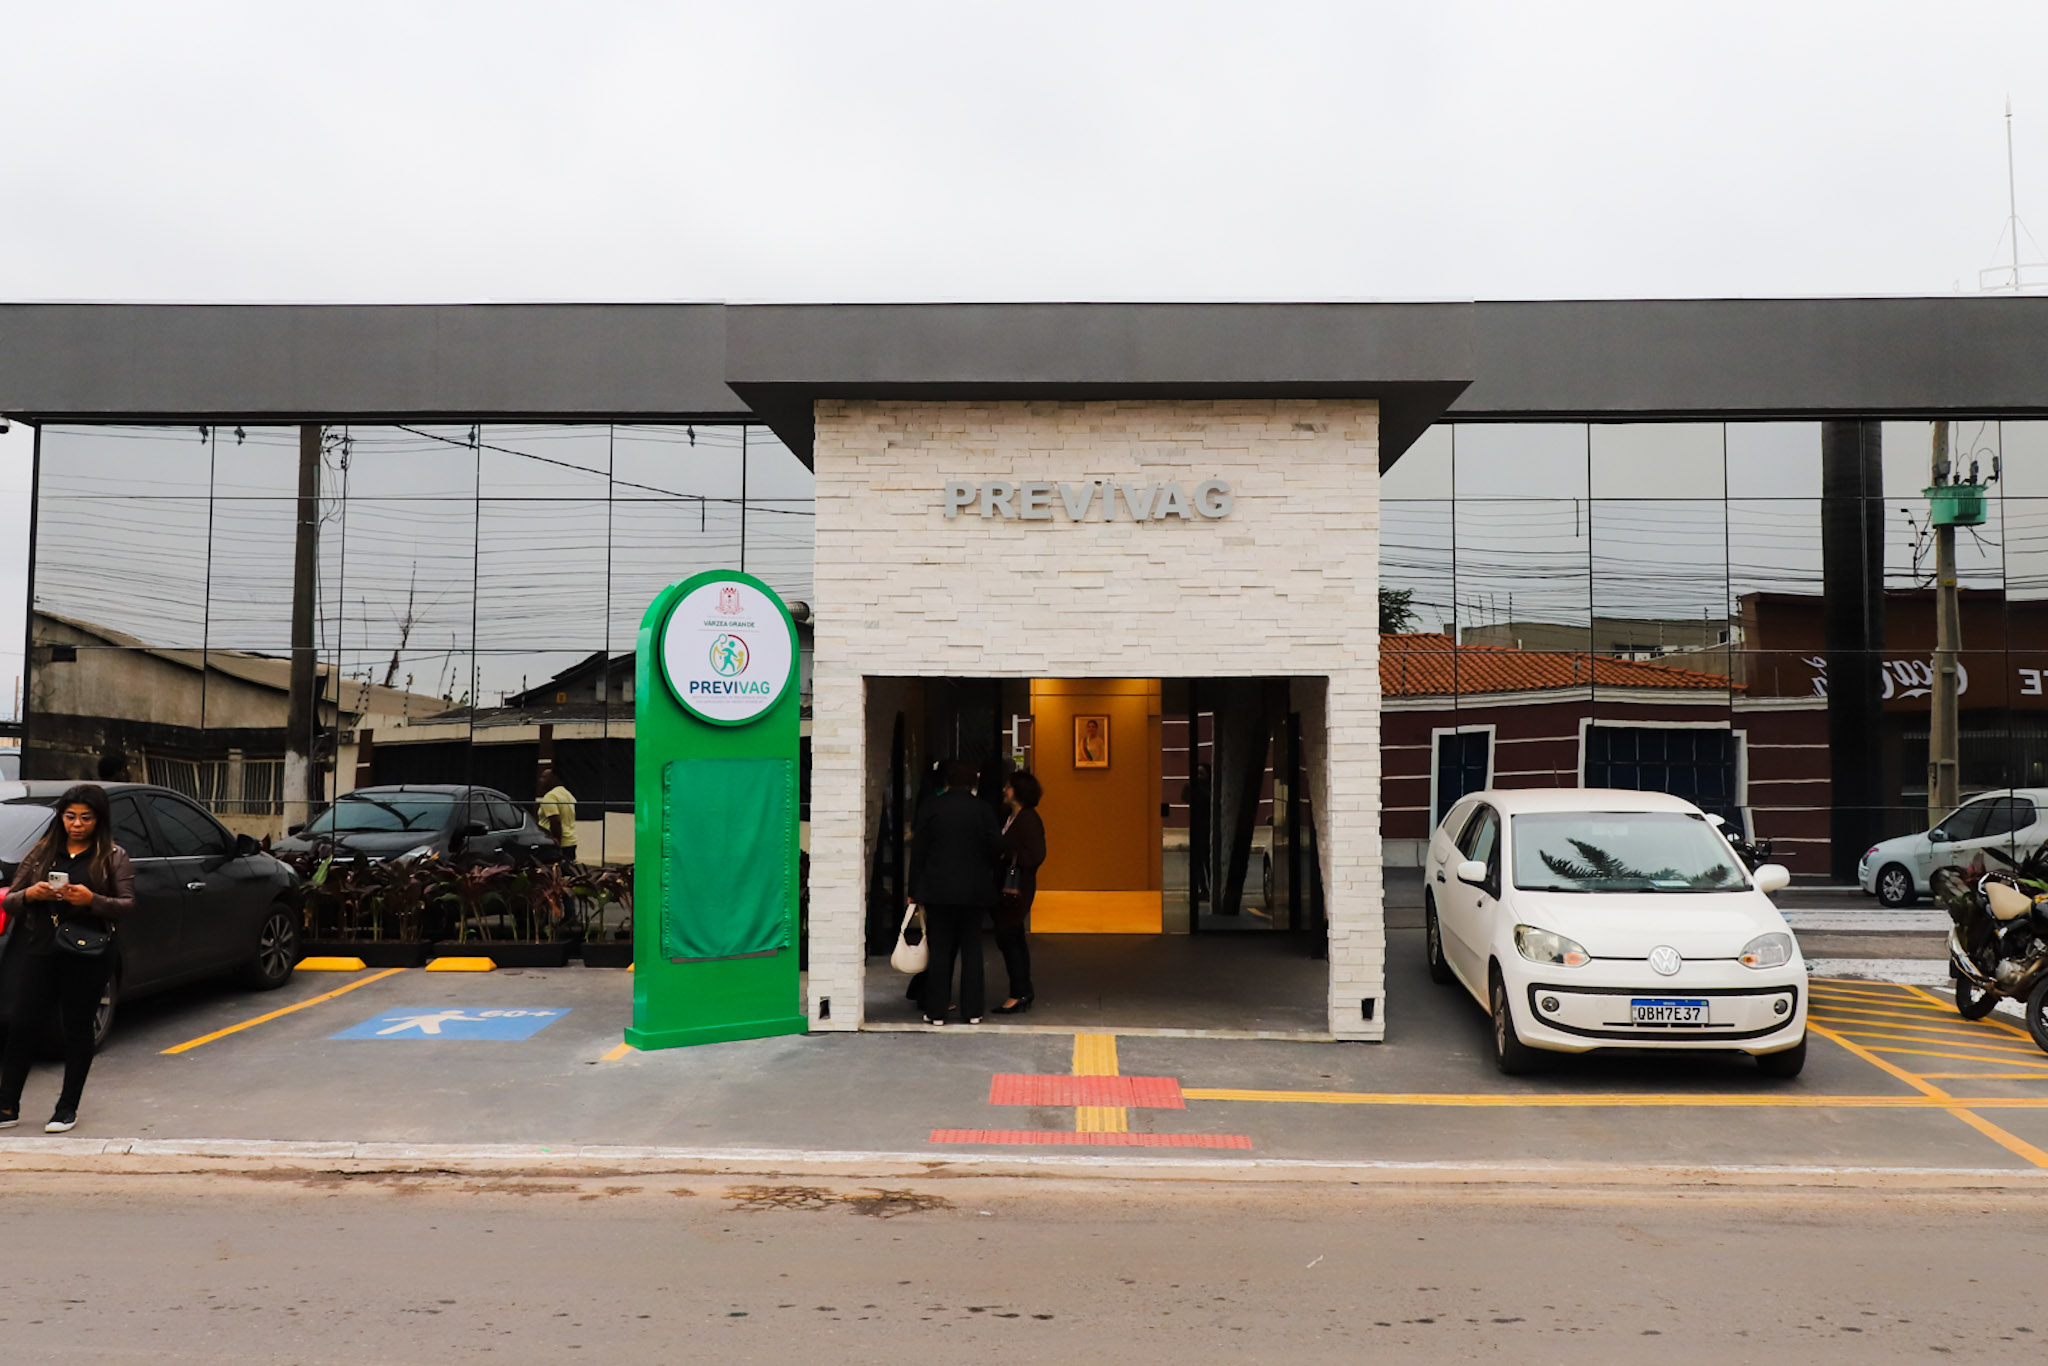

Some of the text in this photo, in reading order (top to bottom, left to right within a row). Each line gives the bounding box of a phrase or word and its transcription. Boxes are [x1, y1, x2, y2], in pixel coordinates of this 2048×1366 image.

[944, 479, 1233, 521] PREVIVAG
[690, 680, 770, 694] PREVIVAG
[1638, 1006, 1700, 1021] QBH7E37
